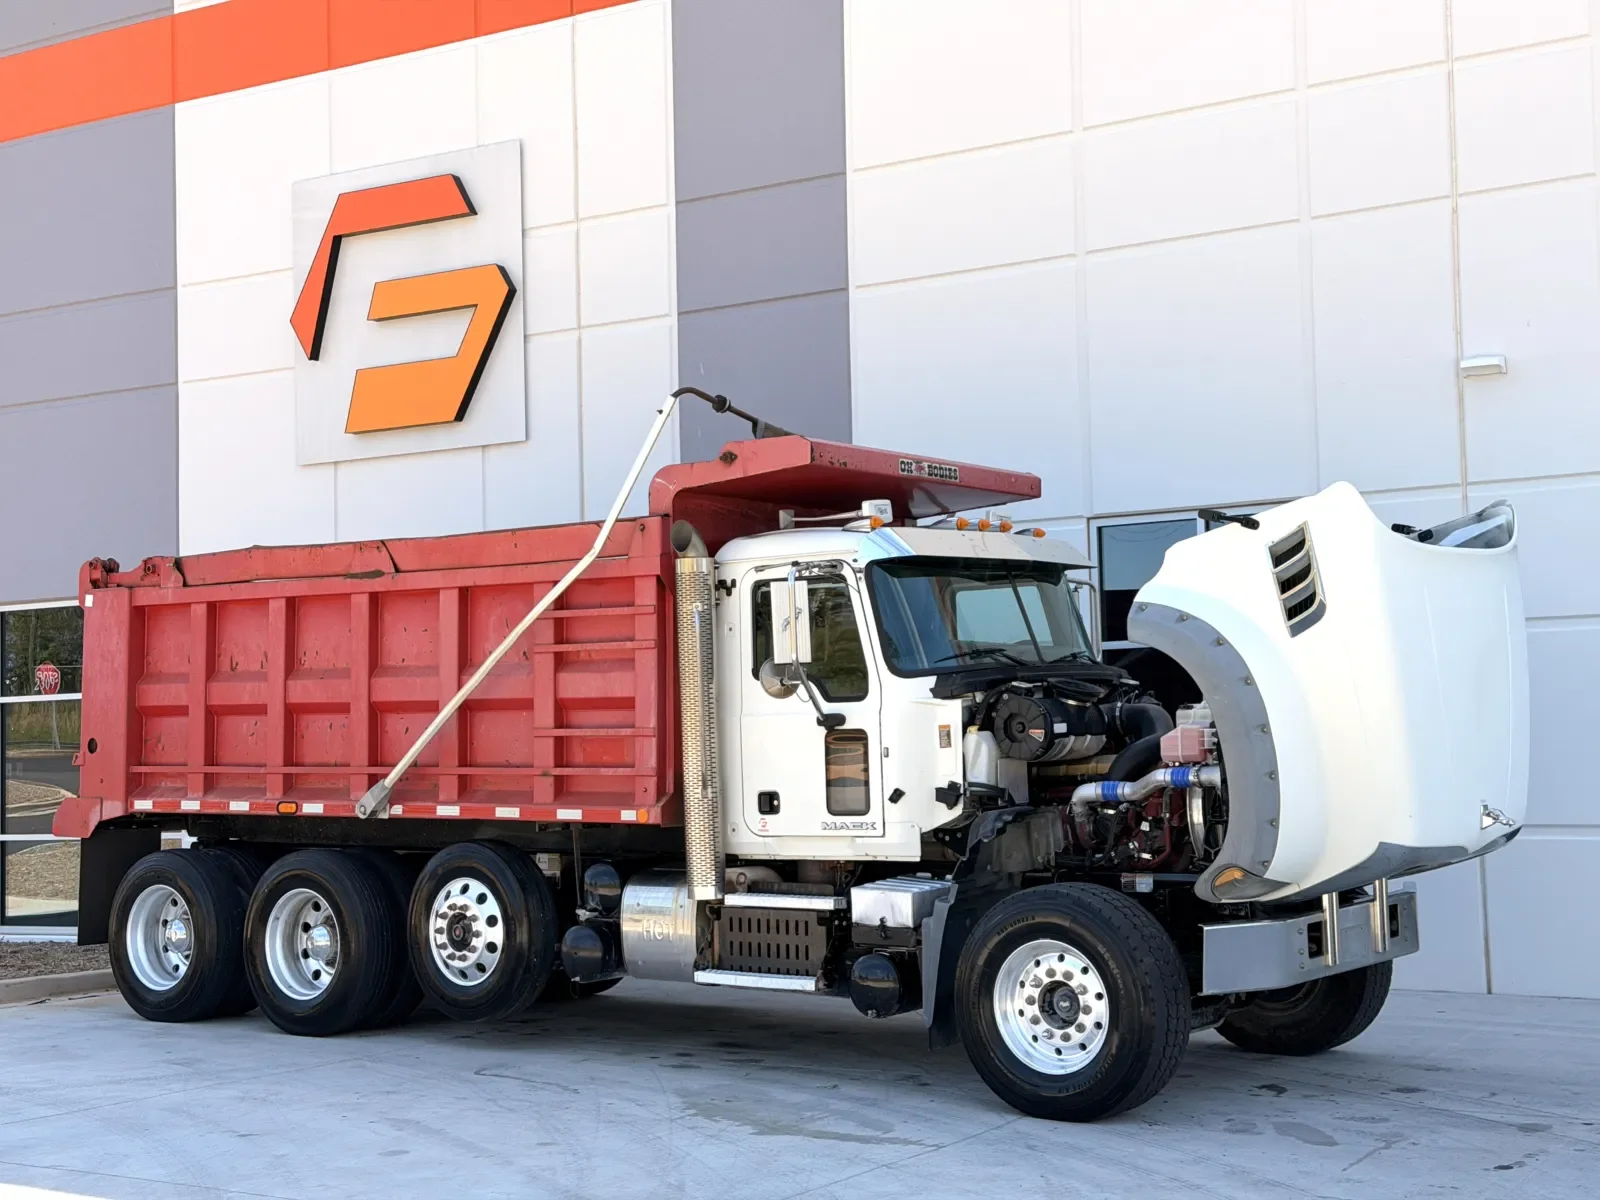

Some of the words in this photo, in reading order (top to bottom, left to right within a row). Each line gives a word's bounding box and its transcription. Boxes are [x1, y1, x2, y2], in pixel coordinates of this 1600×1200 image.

[900, 460, 914, 474] OX
[927, 464, 958, 480] BODIES
[34, 677, 56, 691] 2309
[821, 822, 877, 830] MACK
